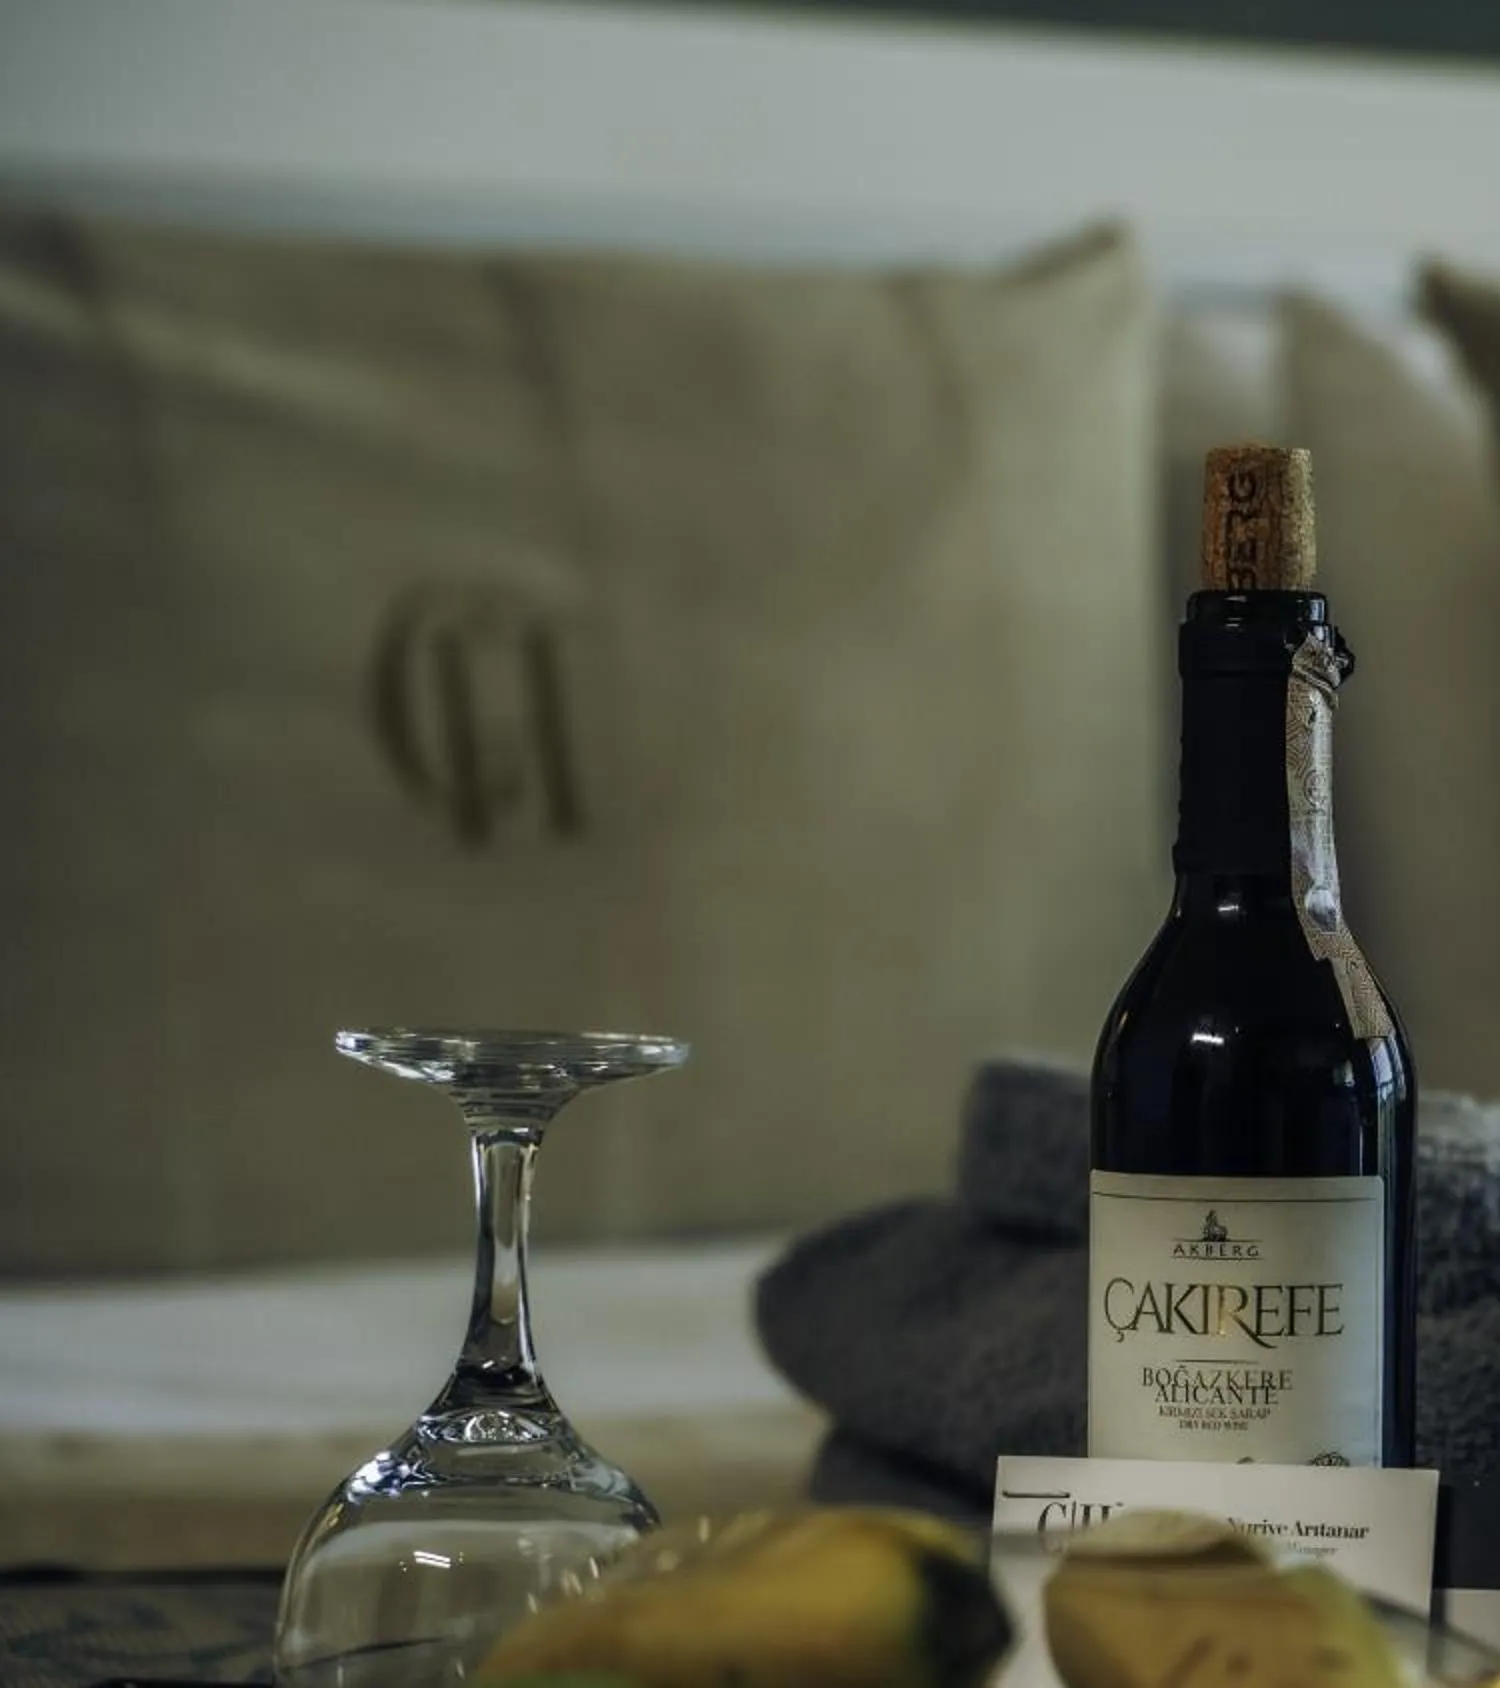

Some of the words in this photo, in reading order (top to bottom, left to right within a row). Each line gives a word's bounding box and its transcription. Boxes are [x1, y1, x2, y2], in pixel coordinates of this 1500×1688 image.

[1172, 1244, 1260, 1257] AKBERG
[1104, 1277, 1345, 1349] ÇAKIREFE
[1142, 1365, 1293, 1391] BOĞAZKERE
[1155, 1381, 1279, 1405] ALICANTE
